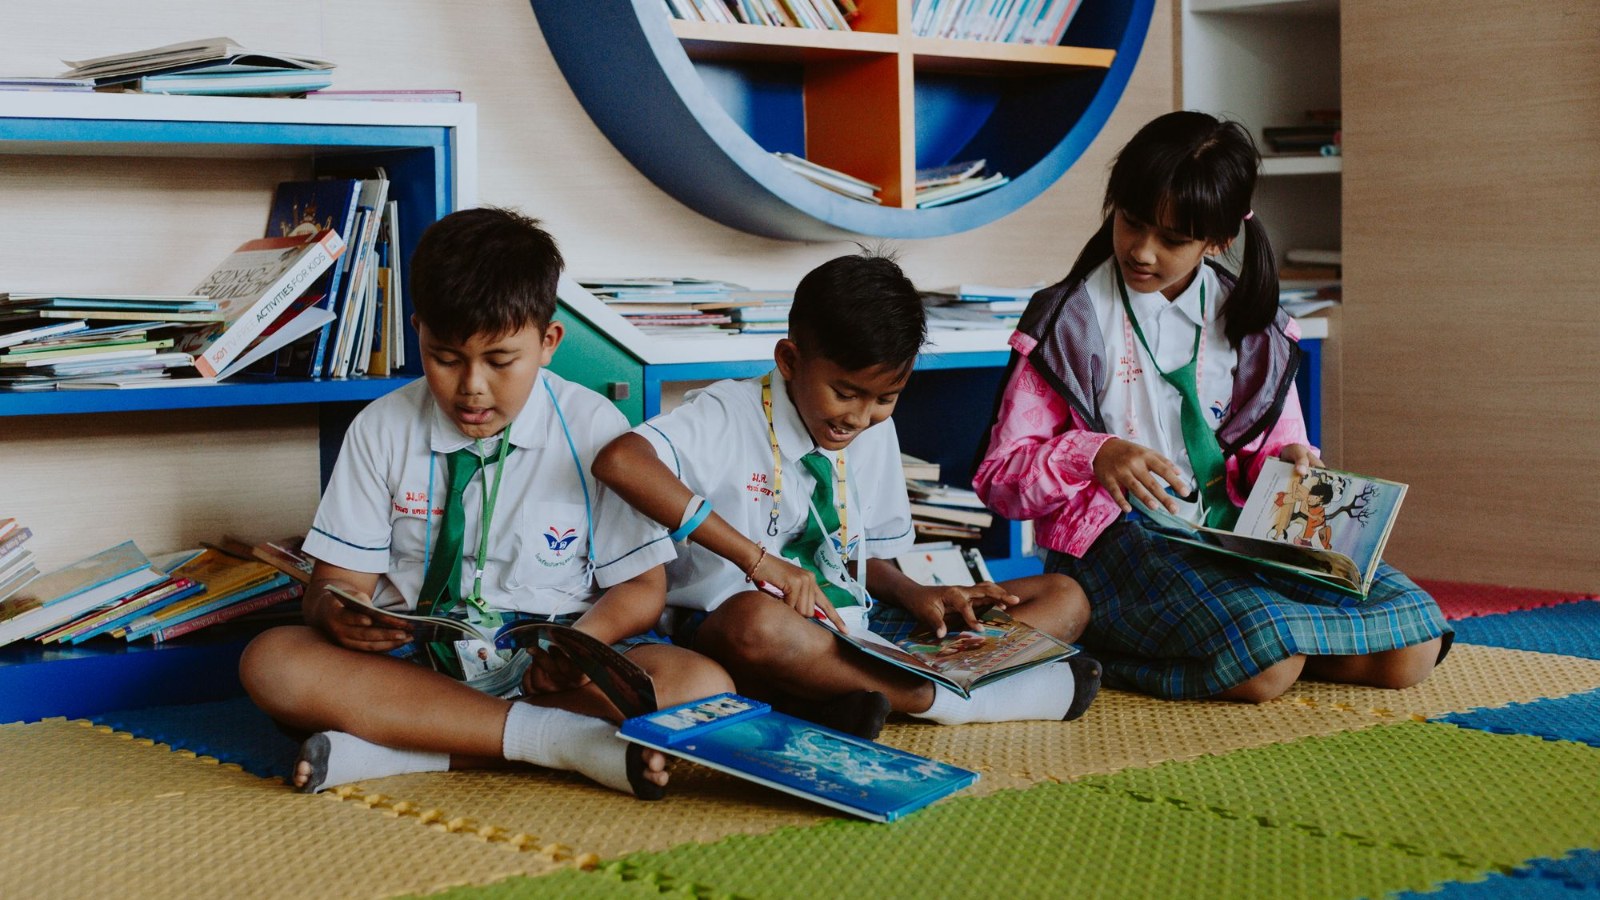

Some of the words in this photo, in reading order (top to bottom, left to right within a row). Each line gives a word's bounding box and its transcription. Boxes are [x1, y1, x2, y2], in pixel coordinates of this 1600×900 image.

[256, 283, 294, 323] ACTIVITIES
[292, 270, 309, 288] FOR
[308, 252, 326, 273] KIDS
